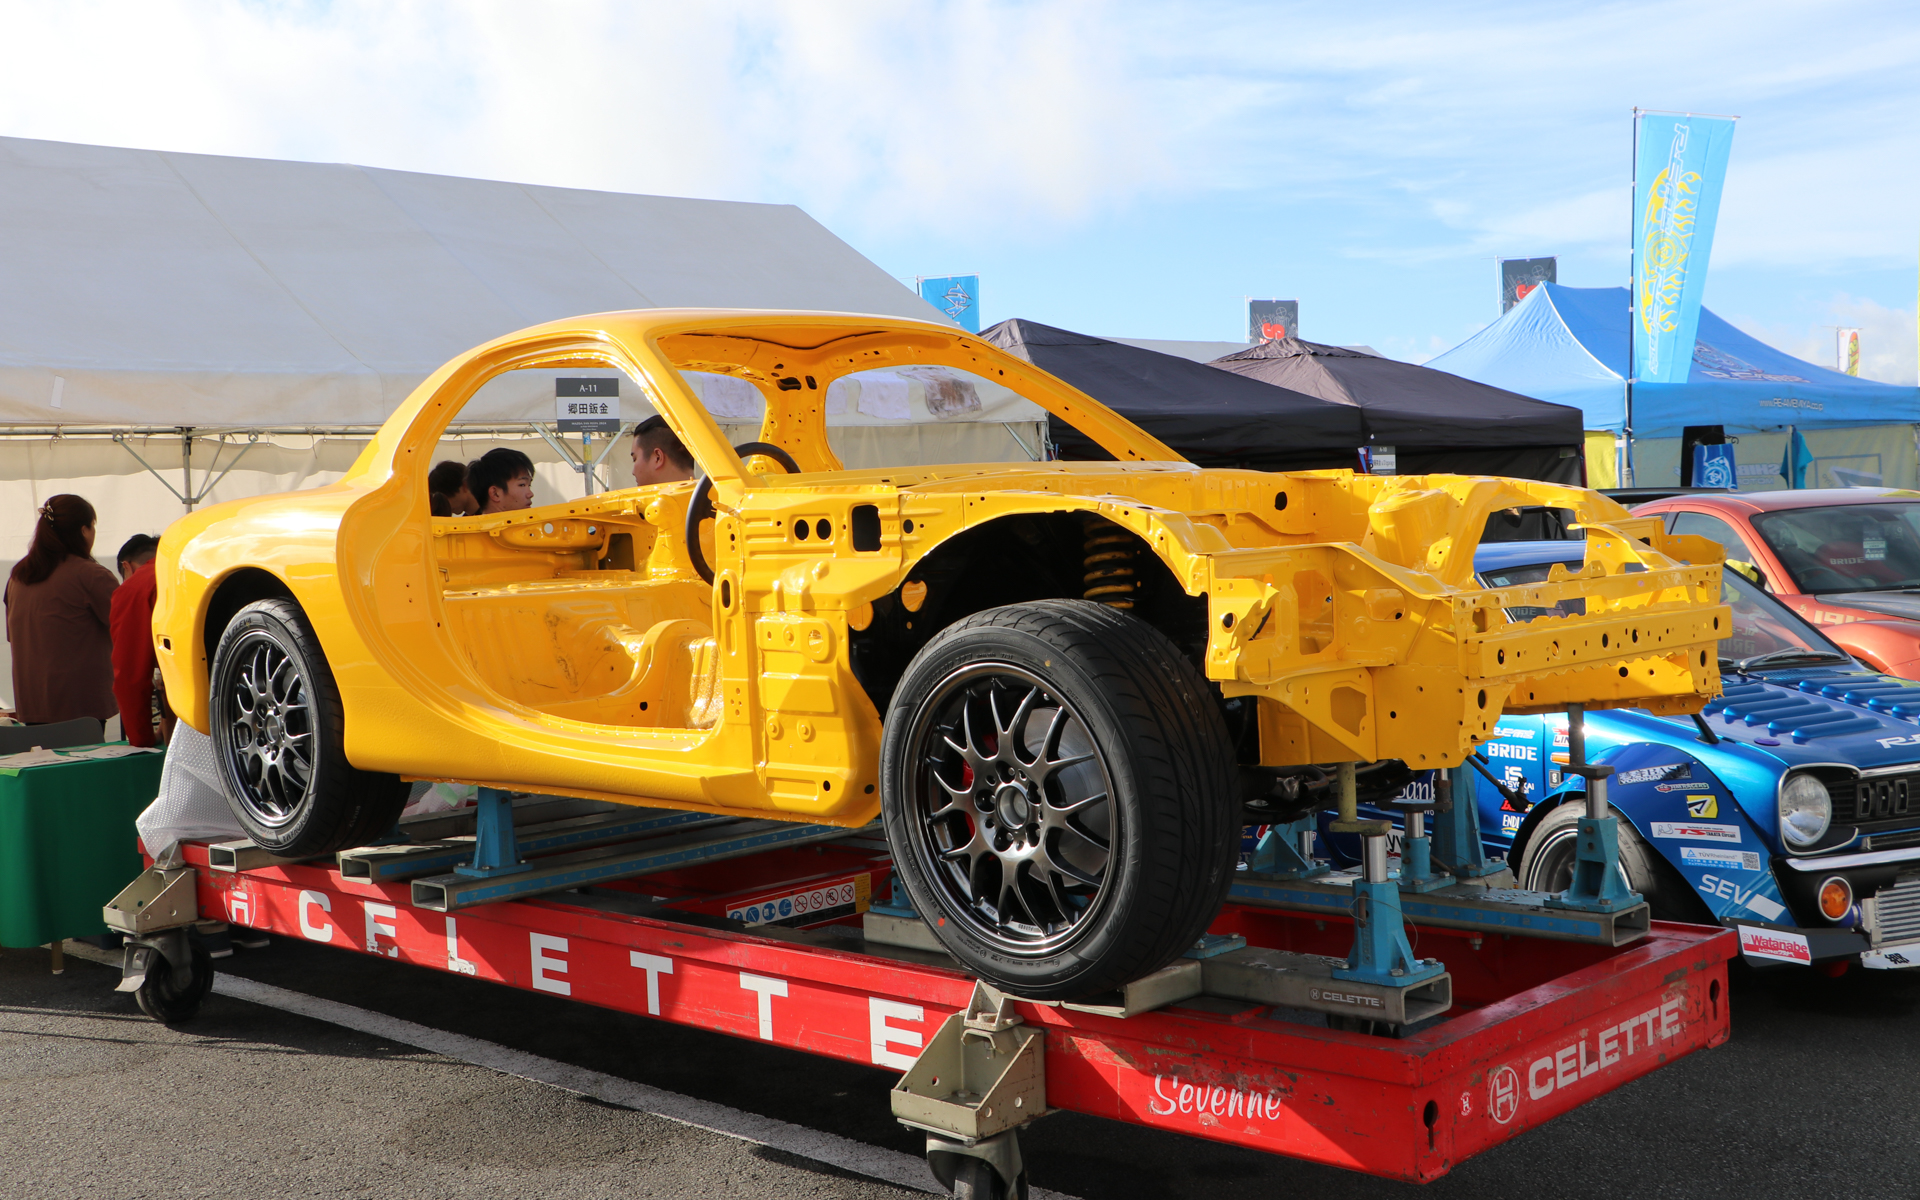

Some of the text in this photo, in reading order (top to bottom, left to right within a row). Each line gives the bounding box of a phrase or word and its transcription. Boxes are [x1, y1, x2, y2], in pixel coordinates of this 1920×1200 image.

[579, 384, 597, 393] A-11
[568, 402, 609, 415] 郷田鈑金
[1829, 557, 1865, 565] BRIDE
[1510, 607, 1537, 616] RIDE
[1487, 742, 1538, 761] BRIDE
[1698, 873, 1753, 905] SEV
[1750, 934, 1808, 953] Watanabe
[1322, 991, 1380, 1007] CELETTE
[1528, 998, 1680, 1101] CELETTE
[1150, 1073, 1281, 1121] Sevenne
